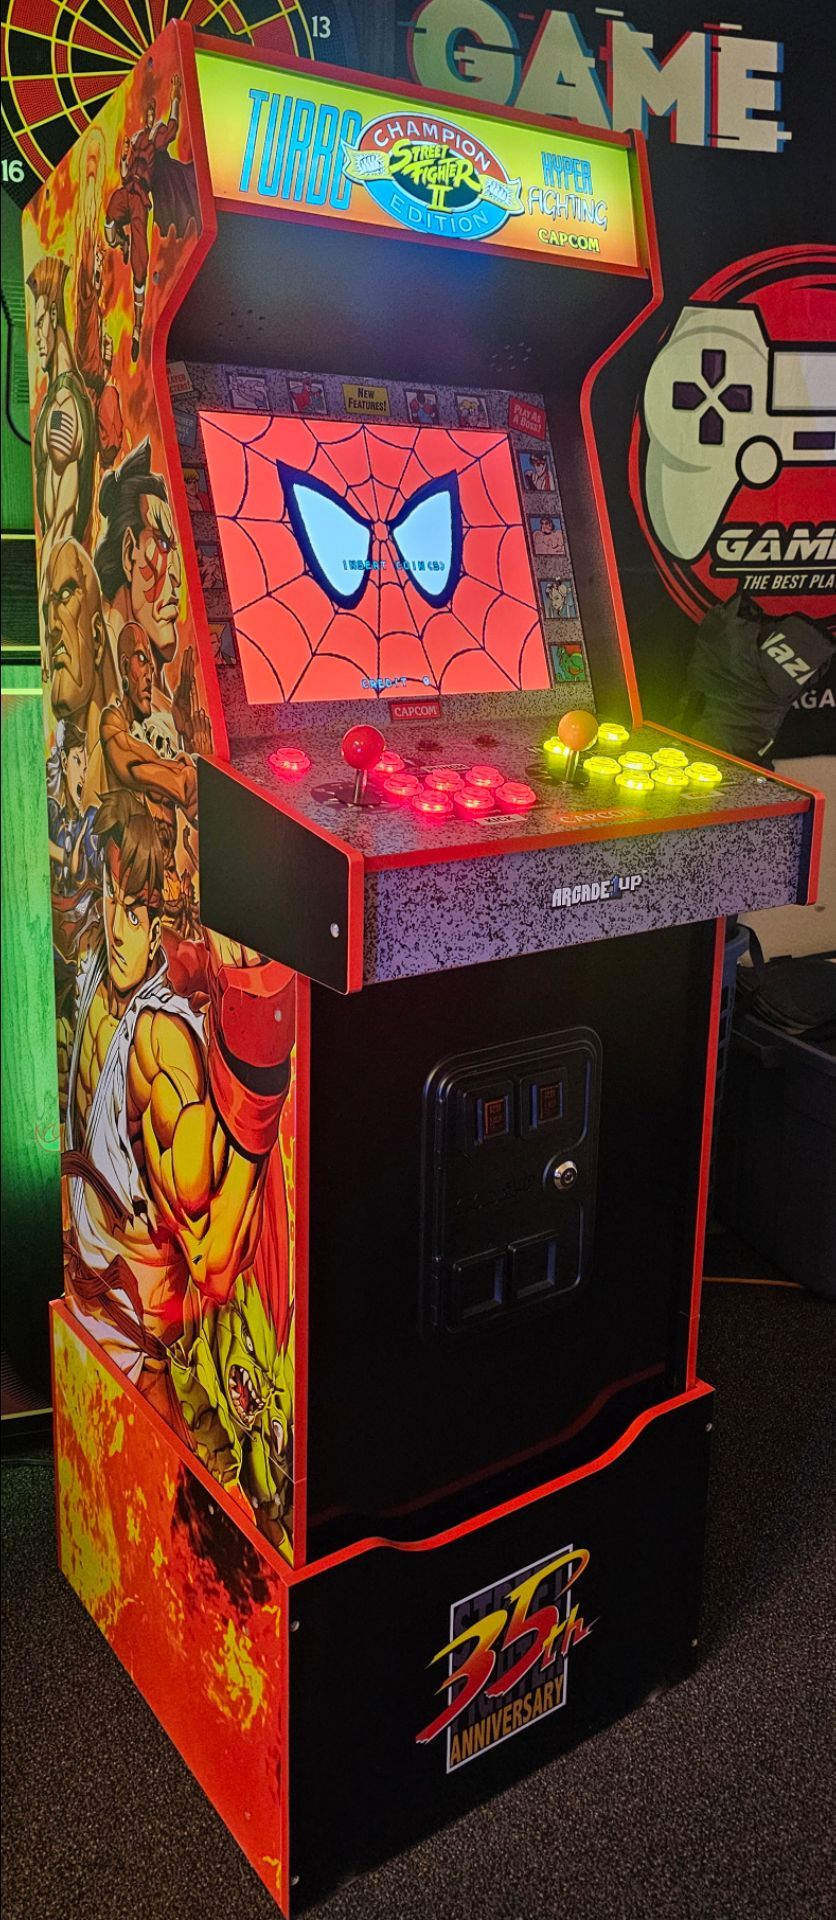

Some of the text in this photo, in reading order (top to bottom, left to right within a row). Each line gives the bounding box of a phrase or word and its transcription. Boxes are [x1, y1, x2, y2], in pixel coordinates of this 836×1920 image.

[311, 15, 331, 38] 13
[406, 0, 789, 153] GAME
[238, 88, 363, 211] TURBO
[374, 120, 491, 171] CHAMPION
[389, 139, 449, 173] STREET
[1, 160, 25, 183] 16
[401, 157, 482, 192] FIGHTER
[541, 151, 593, 195] HYPER
[390, 194, 489, 233] EDITION
[427, 184, 453, 212] II
[527, 186, 608, 231] FIGHTING
[538, 228, 600, 252] CAPCOM
[348, 397, 387, 411] FEATURES!
[342, 559, 387, 571] INSERT
[743, 575, 770, 589] THE
[771, 574, 808, 589] BEST
[361, 676, 407, 689] CREDIT
[394, 705, 438, 718] CAPCOM
[449, 1673, 565, 1767] ANNIVERSARY
